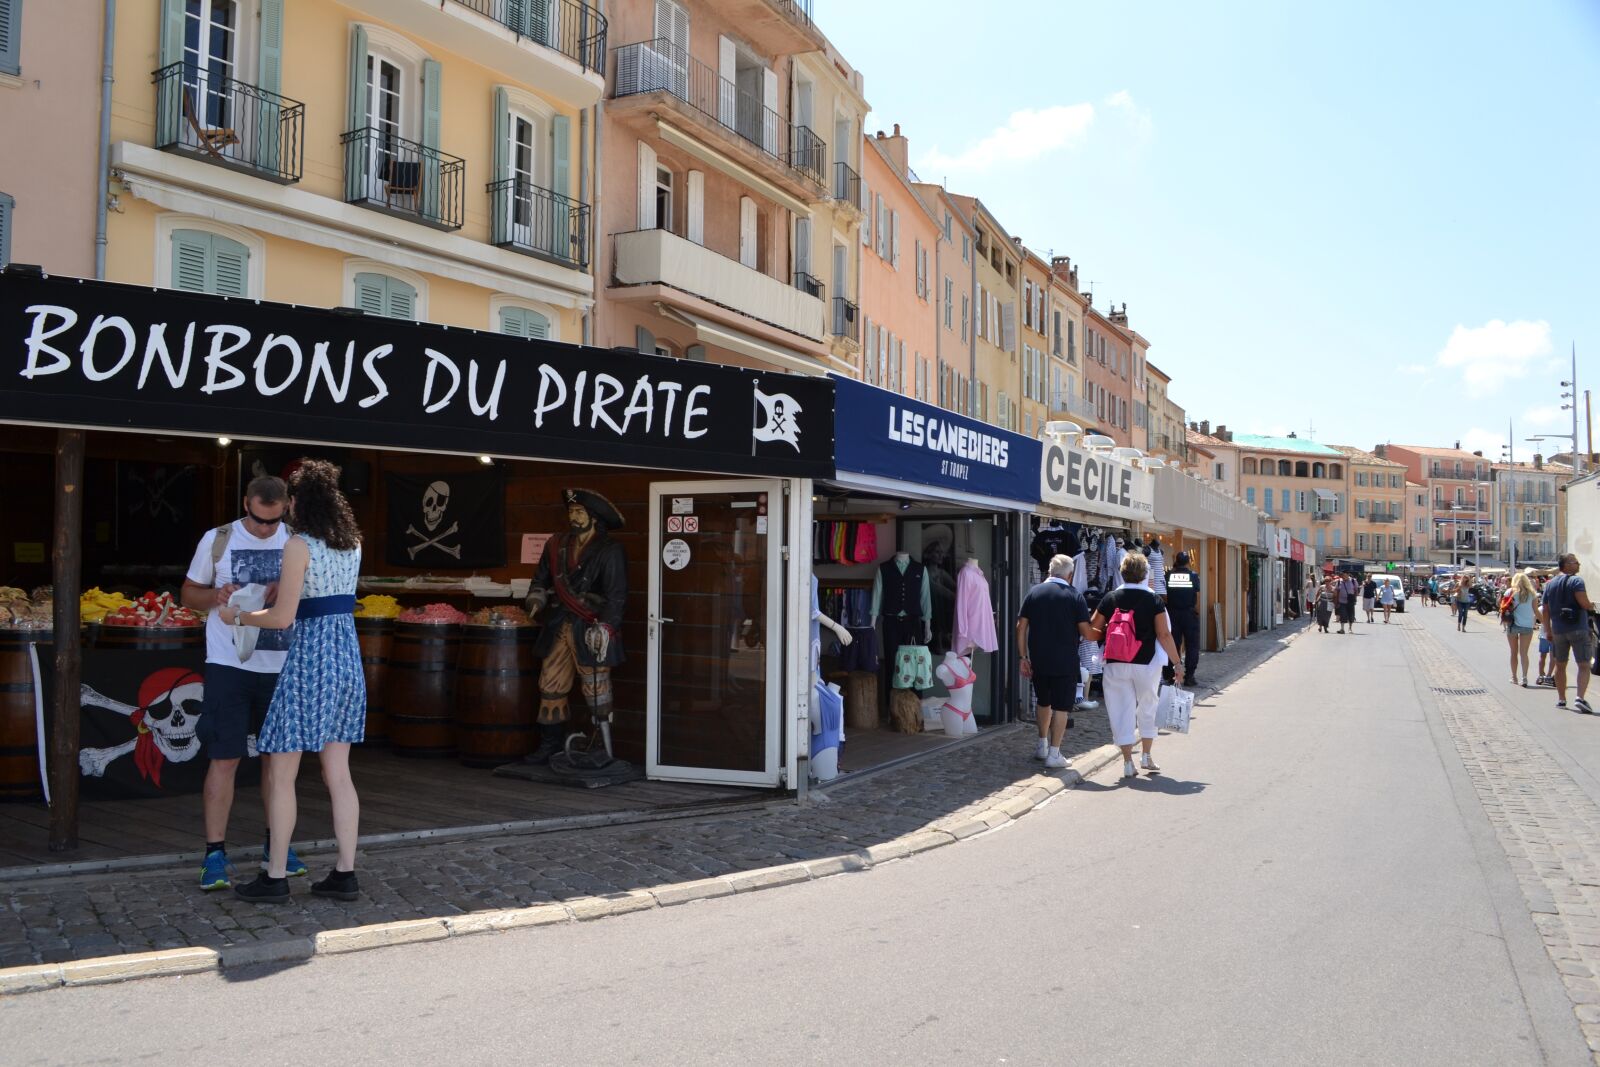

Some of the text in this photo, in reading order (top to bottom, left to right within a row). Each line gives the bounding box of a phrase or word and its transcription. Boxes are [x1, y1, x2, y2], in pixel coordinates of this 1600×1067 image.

[20, 304, 710, 439] BONBONS DU PIRATE
[888, 406, 1009, 468] LES CANEBIERS
[941, 460, 969, 481] ST TROPEZ
[1046, 445, 1132, 507] CECILE
